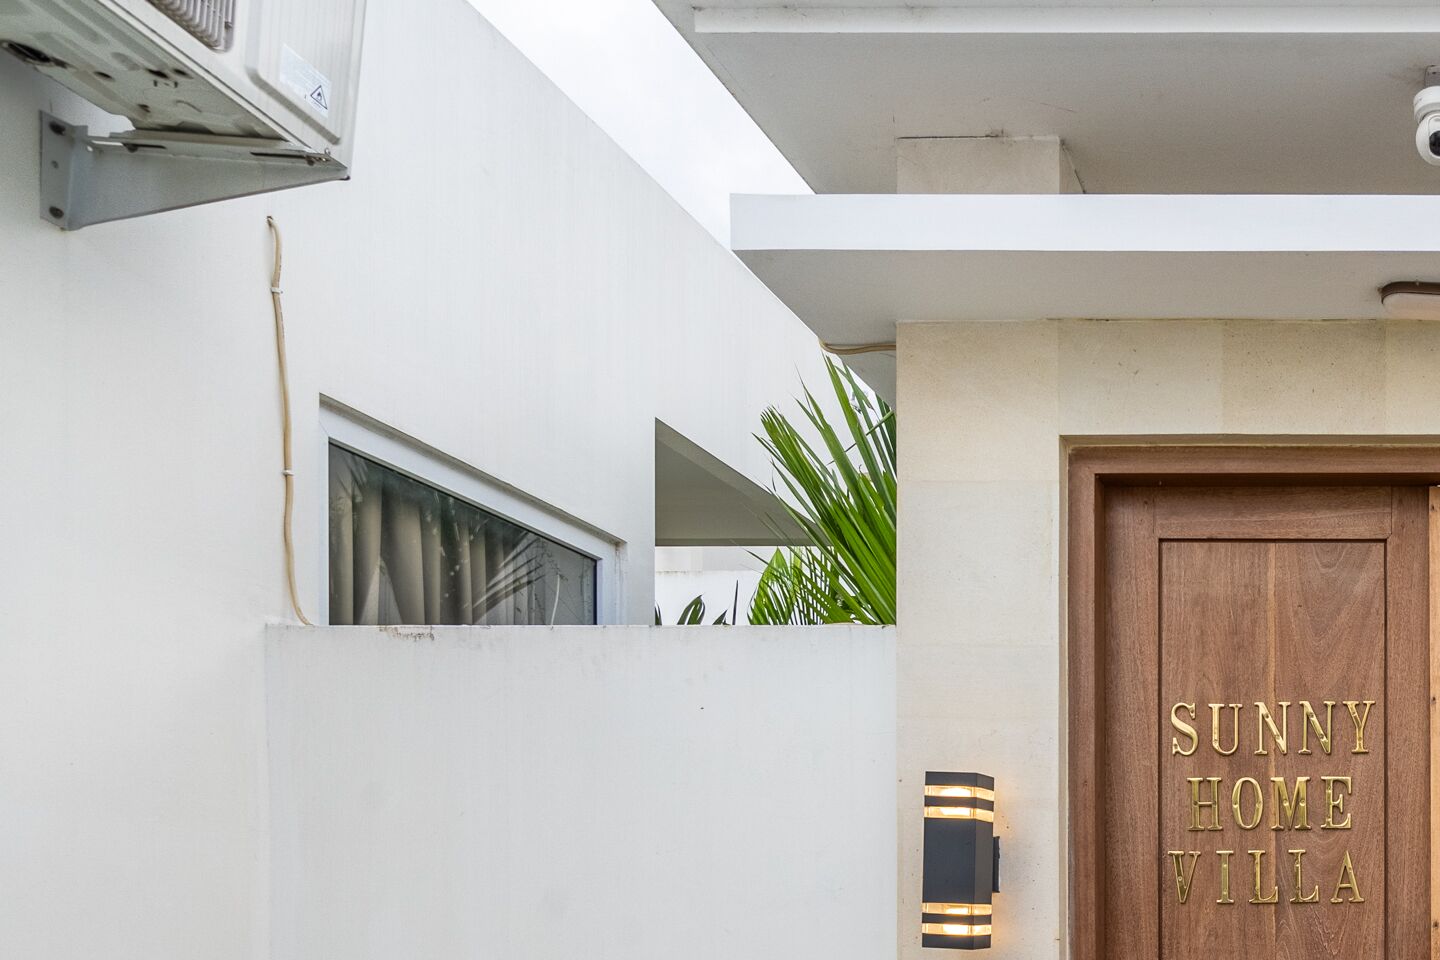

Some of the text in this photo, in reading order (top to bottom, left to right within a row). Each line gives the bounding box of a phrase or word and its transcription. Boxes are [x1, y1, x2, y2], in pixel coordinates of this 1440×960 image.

[1170, 701, 1376, 756] SUNNY
[1186, 776, 1352, 831] HOME
[1167, 850, 1366, 904] VILLA
